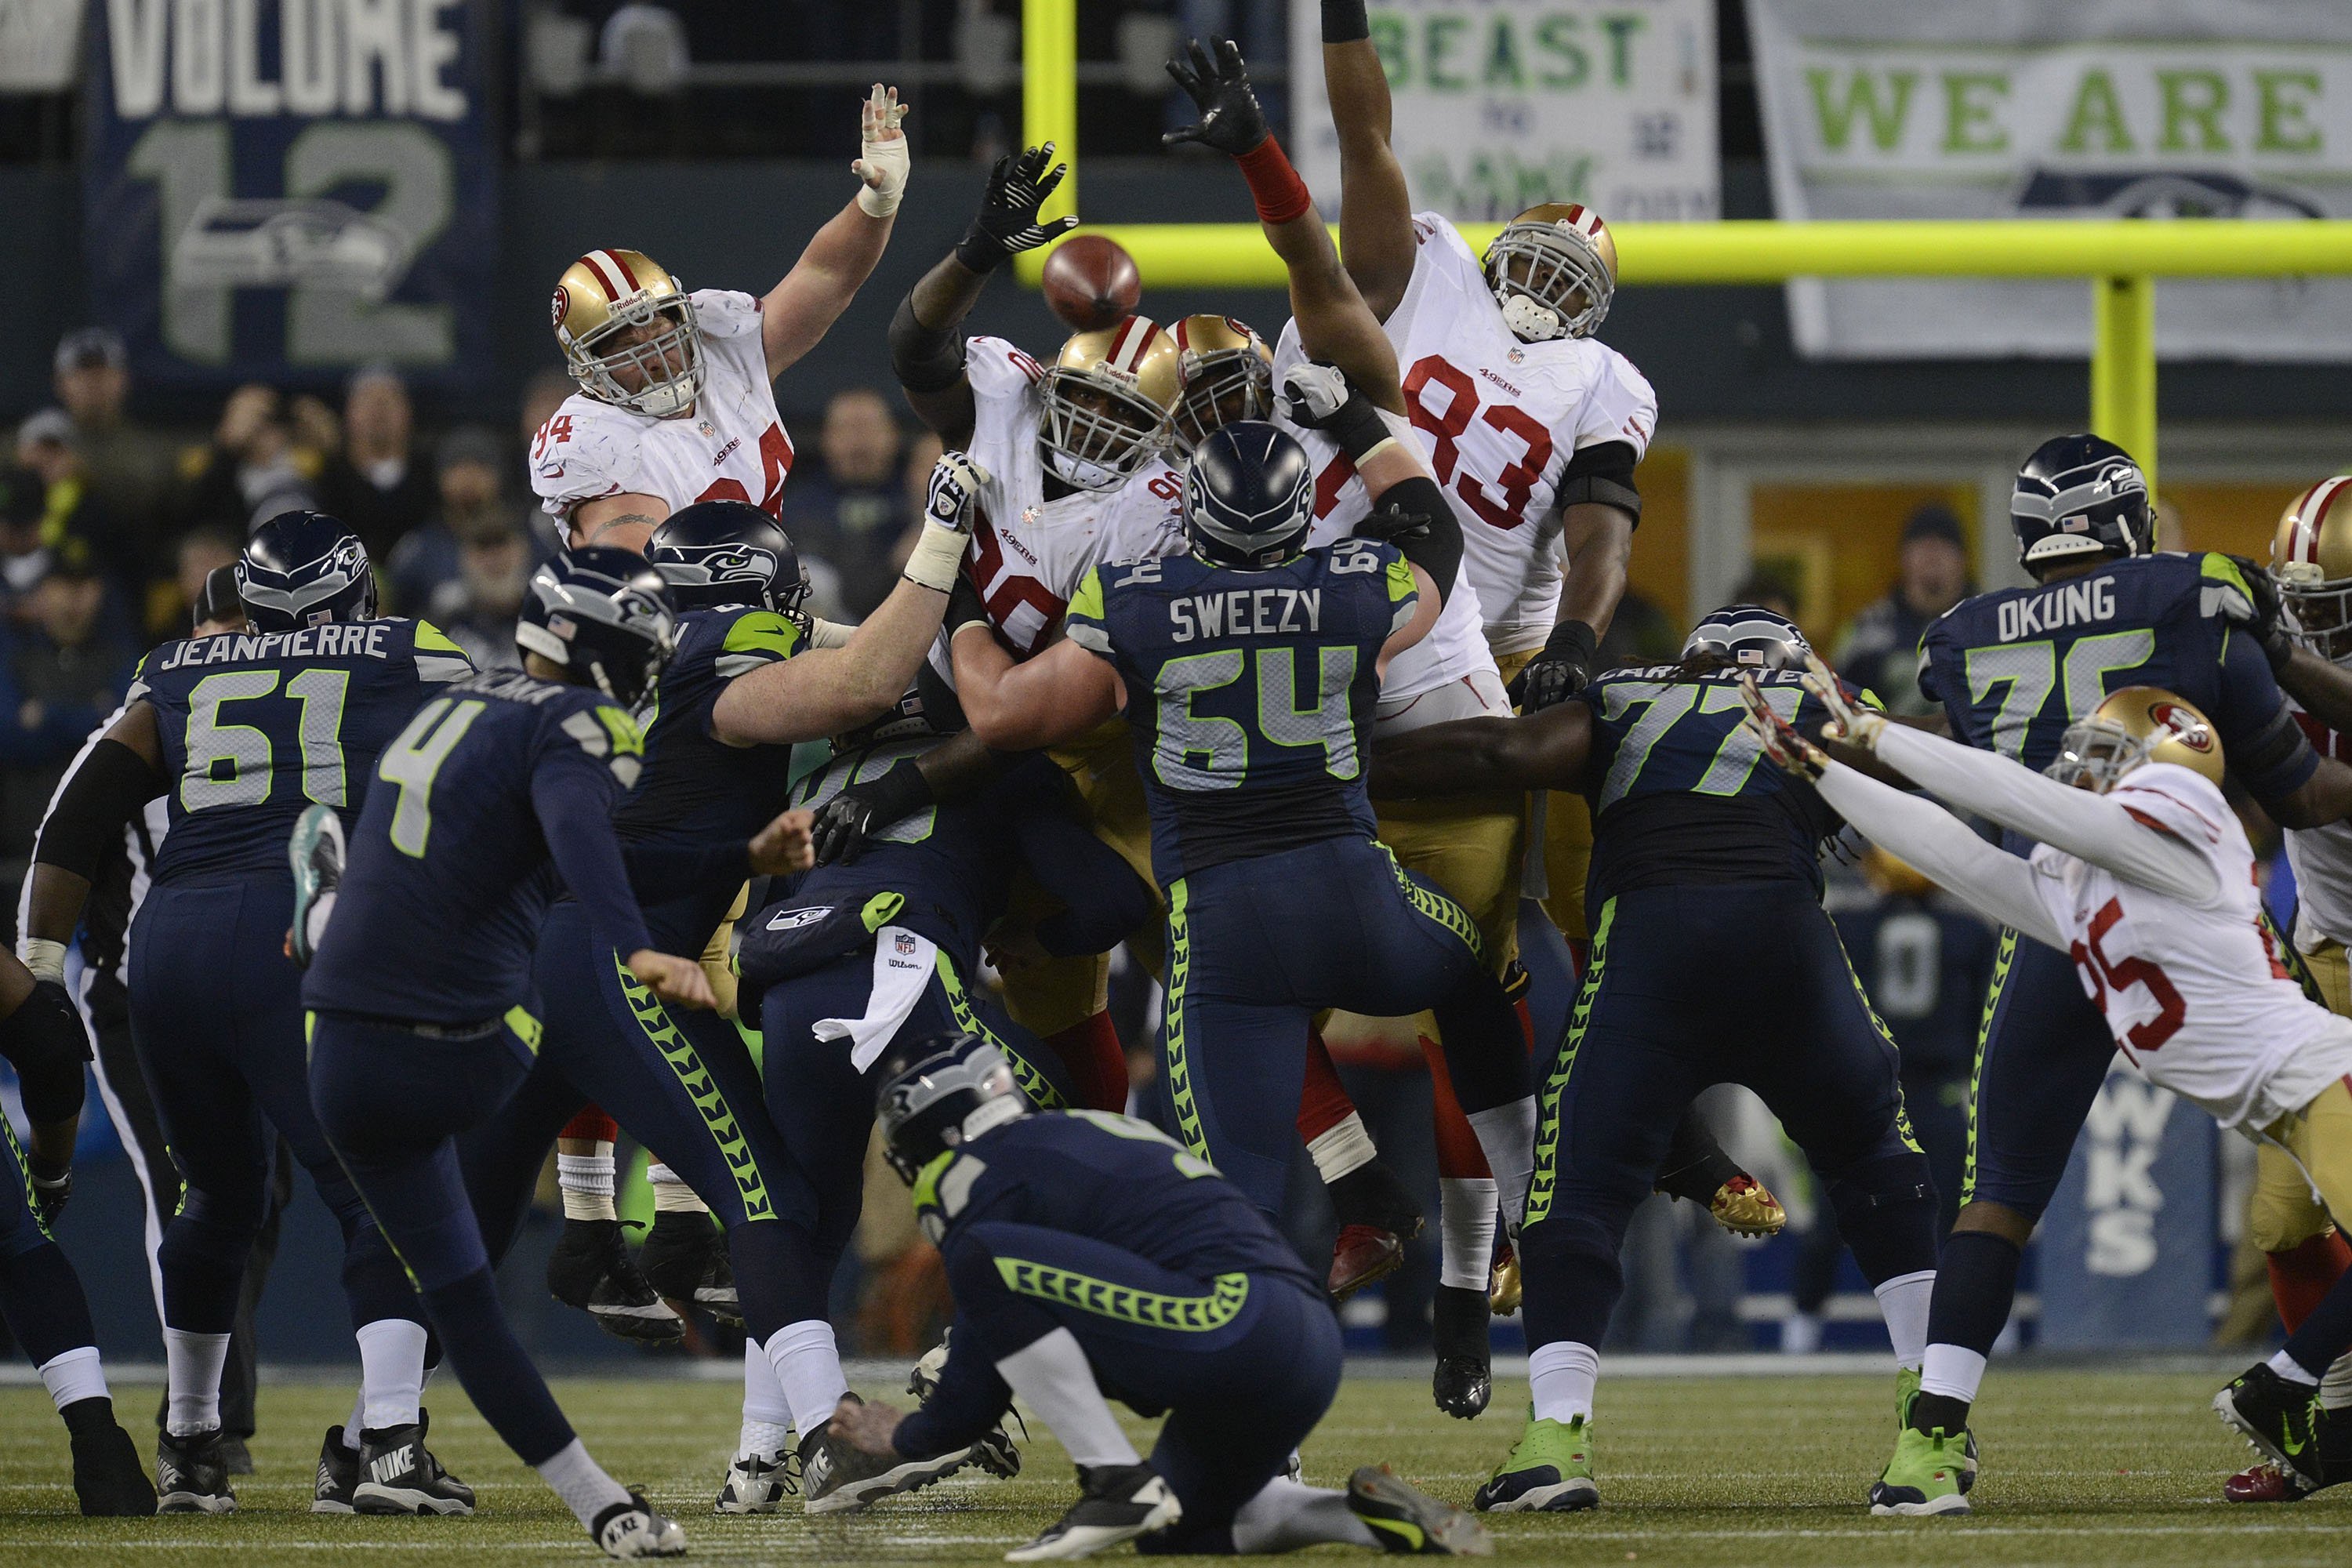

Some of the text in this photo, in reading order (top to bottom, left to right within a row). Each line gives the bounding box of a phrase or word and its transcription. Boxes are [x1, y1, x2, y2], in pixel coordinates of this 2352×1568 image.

[107, 0, 469, 120] VOLUME
[1803, 64, 2324, 154] WE ARE
[125, 118, 463, 367] 12
[1479, 368, 1522, 398] 49ERS
[713, 436, 742, 466] 49ERS
[1402, 354, 1552, 531] 83
[1000, 528, 1039, 568] 49ERS
[161, 625, 391, 670] JEANPIERRE
[1170, 588, 1320, 643] SWEEZY
[1998, 575, 2116, 644] OKUNG
[180, 668, 350, 814] 61
[1151, 645, 1360, 791] 64
[1597, 680, 1806, 818] 77
[378, 696, 488, 859] 4
[888, 959, 919, 970] Wilson
[370, 1443, 414, 1485] NIKE
